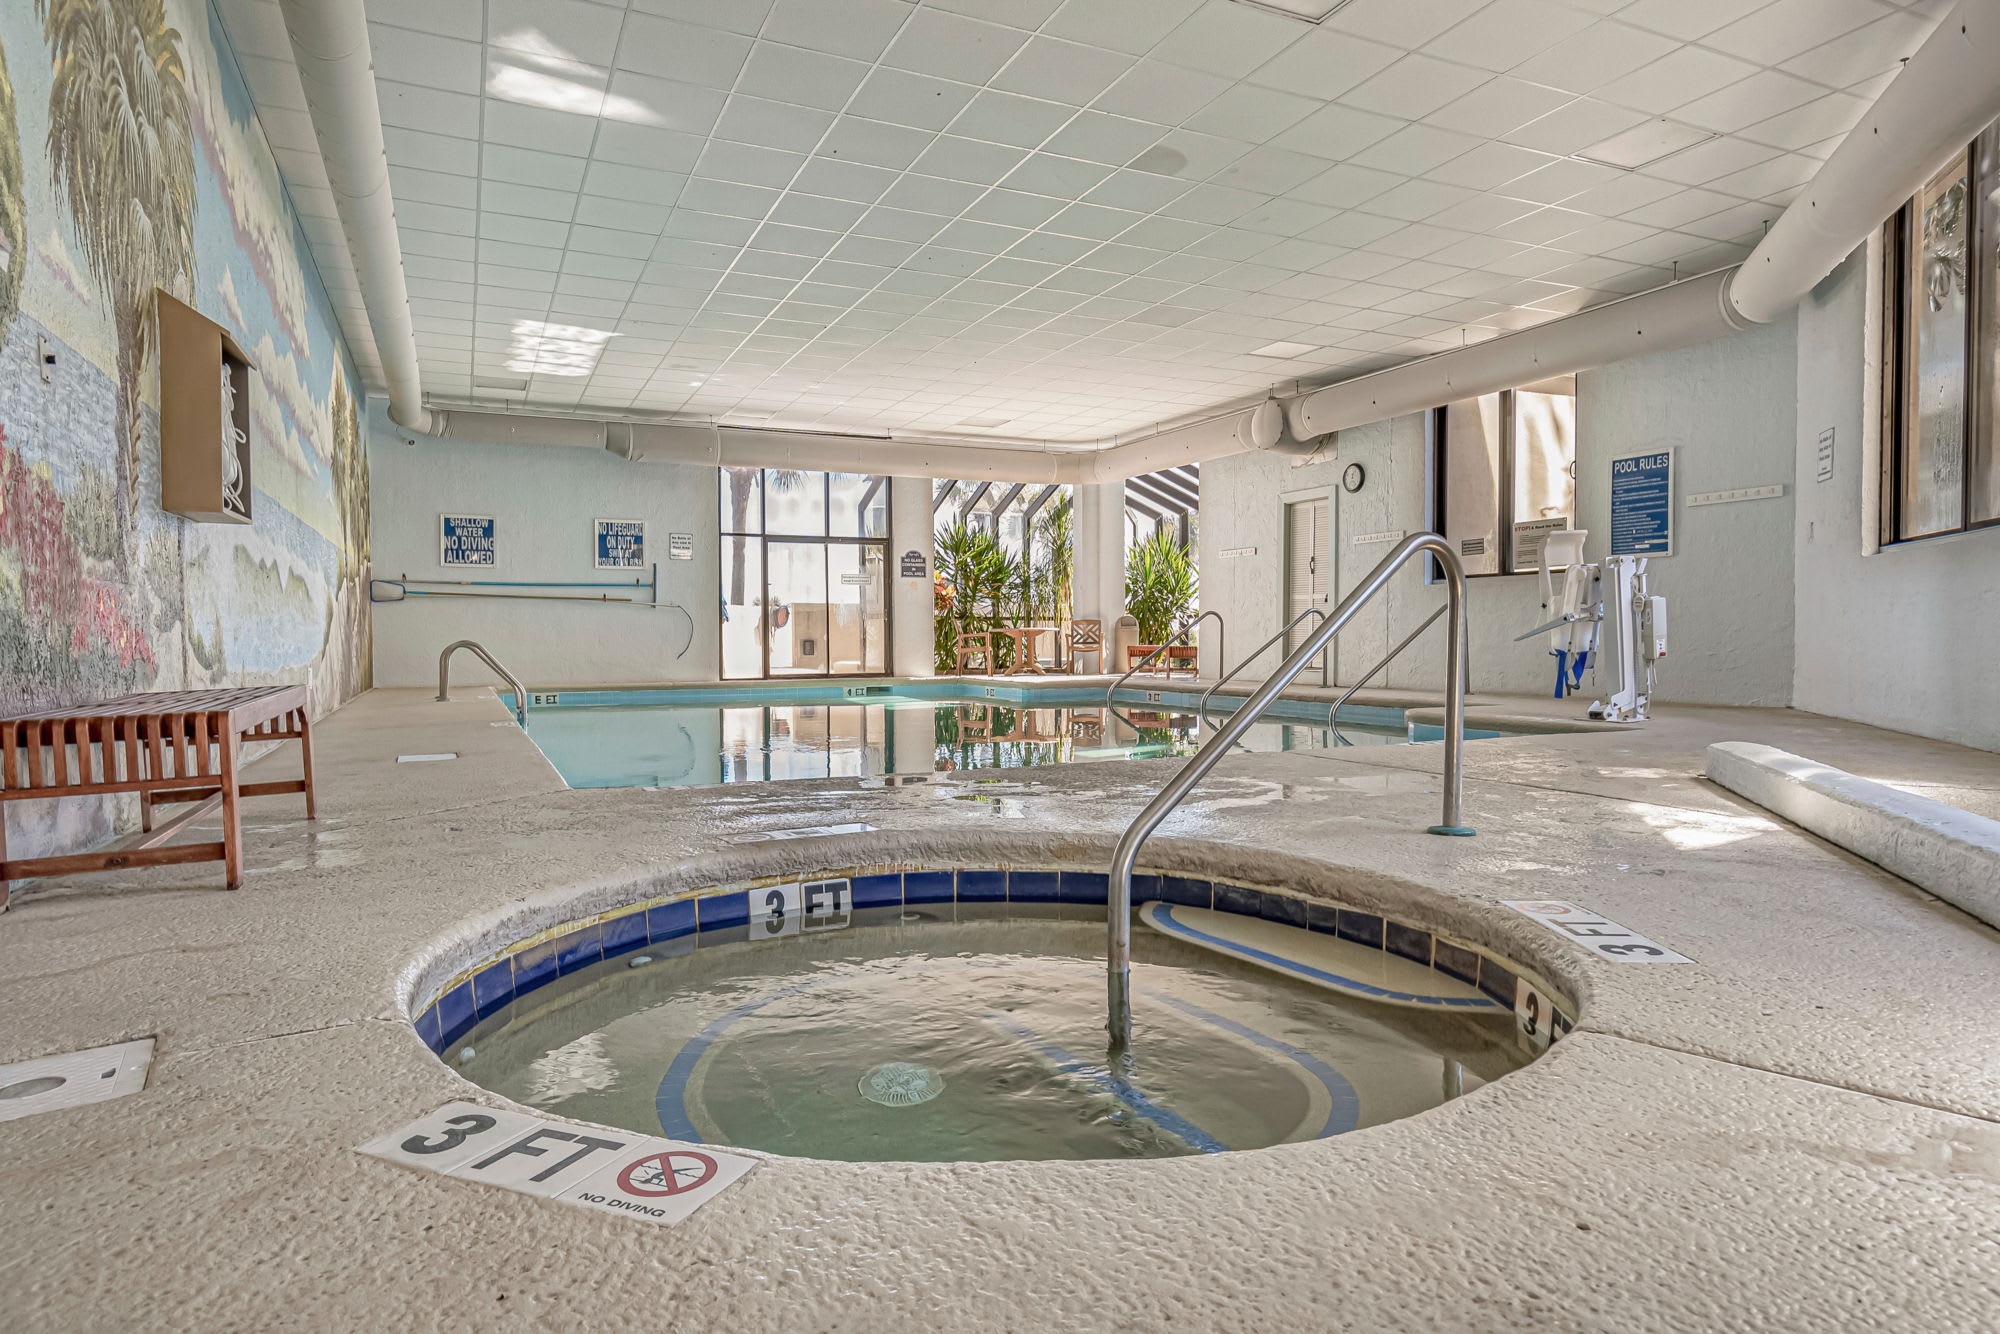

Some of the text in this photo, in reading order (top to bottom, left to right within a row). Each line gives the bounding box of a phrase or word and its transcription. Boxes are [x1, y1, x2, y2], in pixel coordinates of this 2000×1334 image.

[1614, 455, 1668, 474] POOL RULES
[450, 518, 489, 528] SHALLOW
[598, 522, 607, 535] NO
[455, 528, 484, 536] WATER
[445, 536, 494, 550] NO DIVING
[606, 536, 635, 550] ON DUTY
[446, 550, 493, 564] ALLOWED
[608, 549, 632, 558] SWIM AT
[599, 557, 615, 566] YOUR
[629, 558, 642, 567] RISK
[766, 881, 848, 918] 3 FT
[1598, 944, 1664, 957] 3
[1523, 992, 1539, 1036] 3
[401, 1114, 626, 1183] 3 FT
[578, 1192, 666, 1217] NO DIVING
